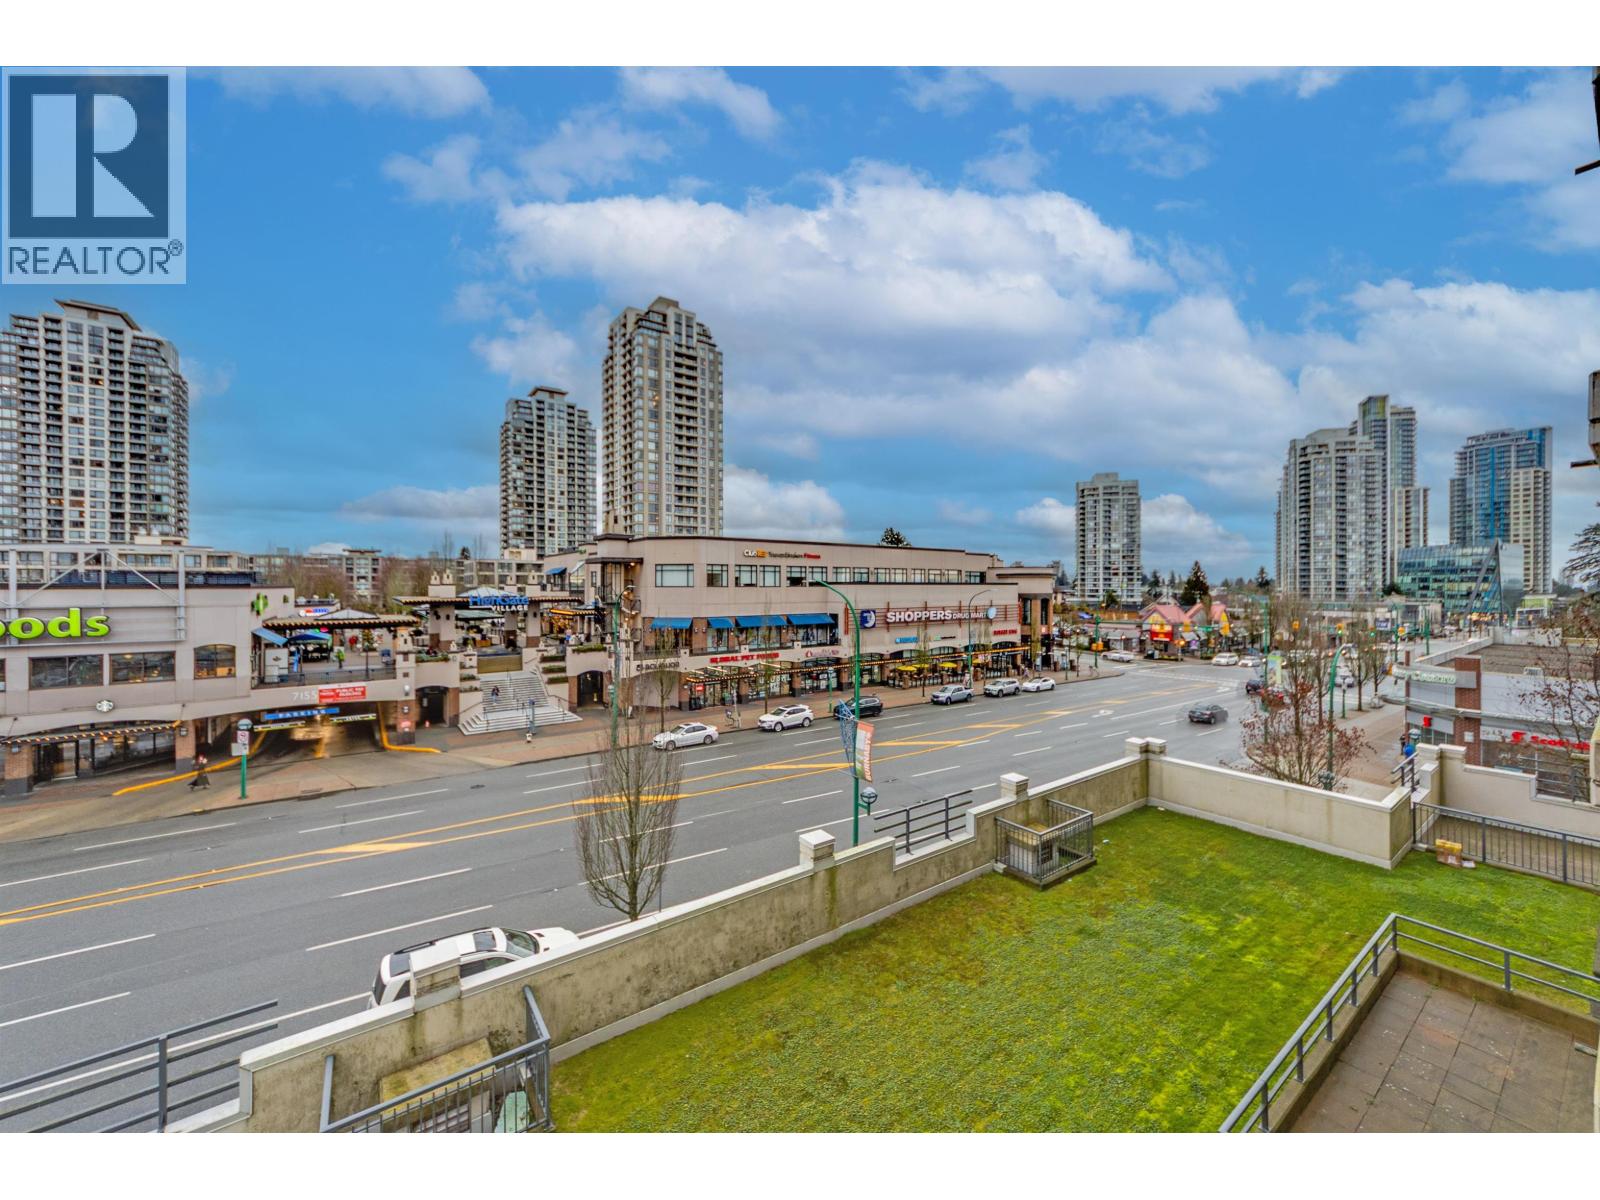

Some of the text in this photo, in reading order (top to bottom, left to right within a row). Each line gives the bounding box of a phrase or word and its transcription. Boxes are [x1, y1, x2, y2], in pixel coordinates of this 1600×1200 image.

[0, 607, 110, 640] ods
[886, 609, 953, 623] SHOPPERS
[953, 612, 970, 620] DRUG
